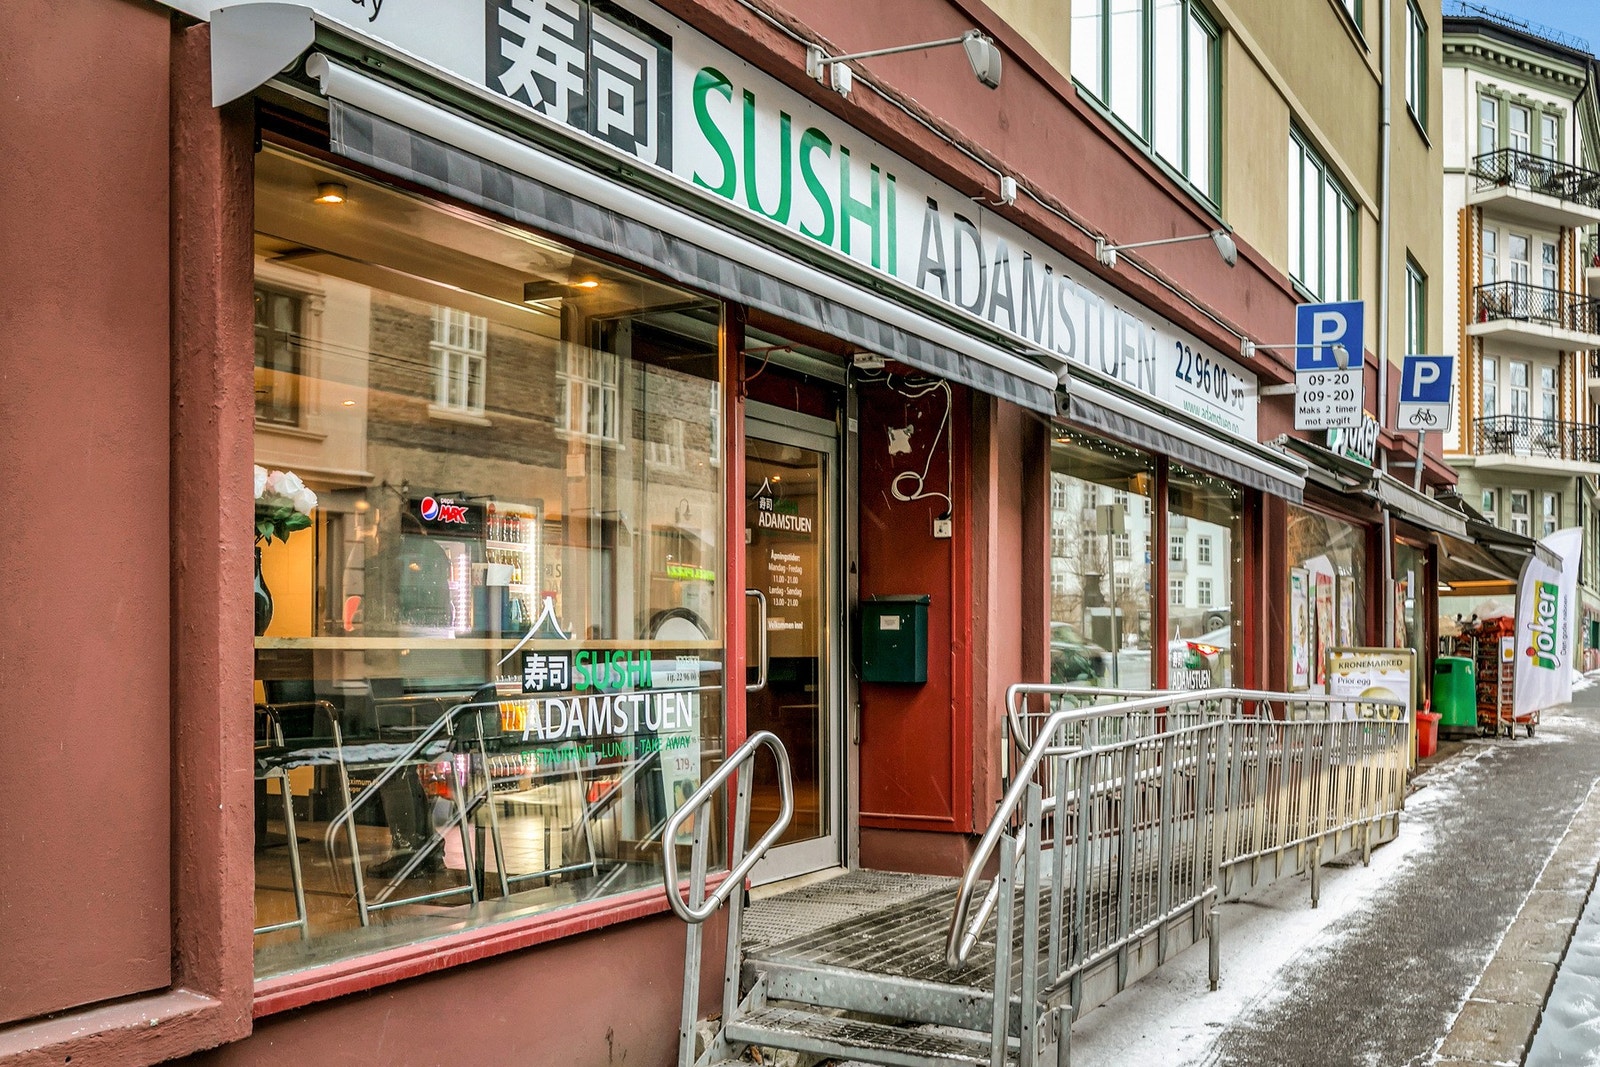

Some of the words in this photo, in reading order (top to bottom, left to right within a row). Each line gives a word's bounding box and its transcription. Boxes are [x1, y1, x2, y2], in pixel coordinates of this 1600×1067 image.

[692, 66, 897, 277] SUSHI
[916, 196, 1157, 396] ADAMSTUEN
[1313, 311, 1347, 362] P
[1175, 341, 1193, 385] 22
[1195, 352, 1211, 394] 96
[1213, 363, 1229, 403] 00
[1412, 361, 1441, 398] P
[1299, 406, 1321, 415] Maks
[1325, 405, 1331, 414] 2
[1335, 404, 1358, 414] timer
[1305, 416, 1322, 426] mot
[1325, 416, 1351, 426] avgift
[437, 504, 469, 524] MAX
[759, 511, 811, 532] ADAMSTUEN
[768, 562, 786, 574] Mandag
[789, 564, 803, 575] Fredag
[1526, 586, 1561, 669] joker
[523, 653, 569, 691] 寿司
[575, 650, 652, 690] SUSHI
[1338, 659, 1403, 669] KRONEMARKED
[1173, 670, 1211, 690] ADAMSTUEN
[1337, 677, 1355, 685] Prior
[522, 692, 693, 741] ADAMSTUEN
[521, 744, 593, 766] RESTAURANT
[640, 738, 662, 754] TAKE
[665, 735, 692, 751] AWAY
